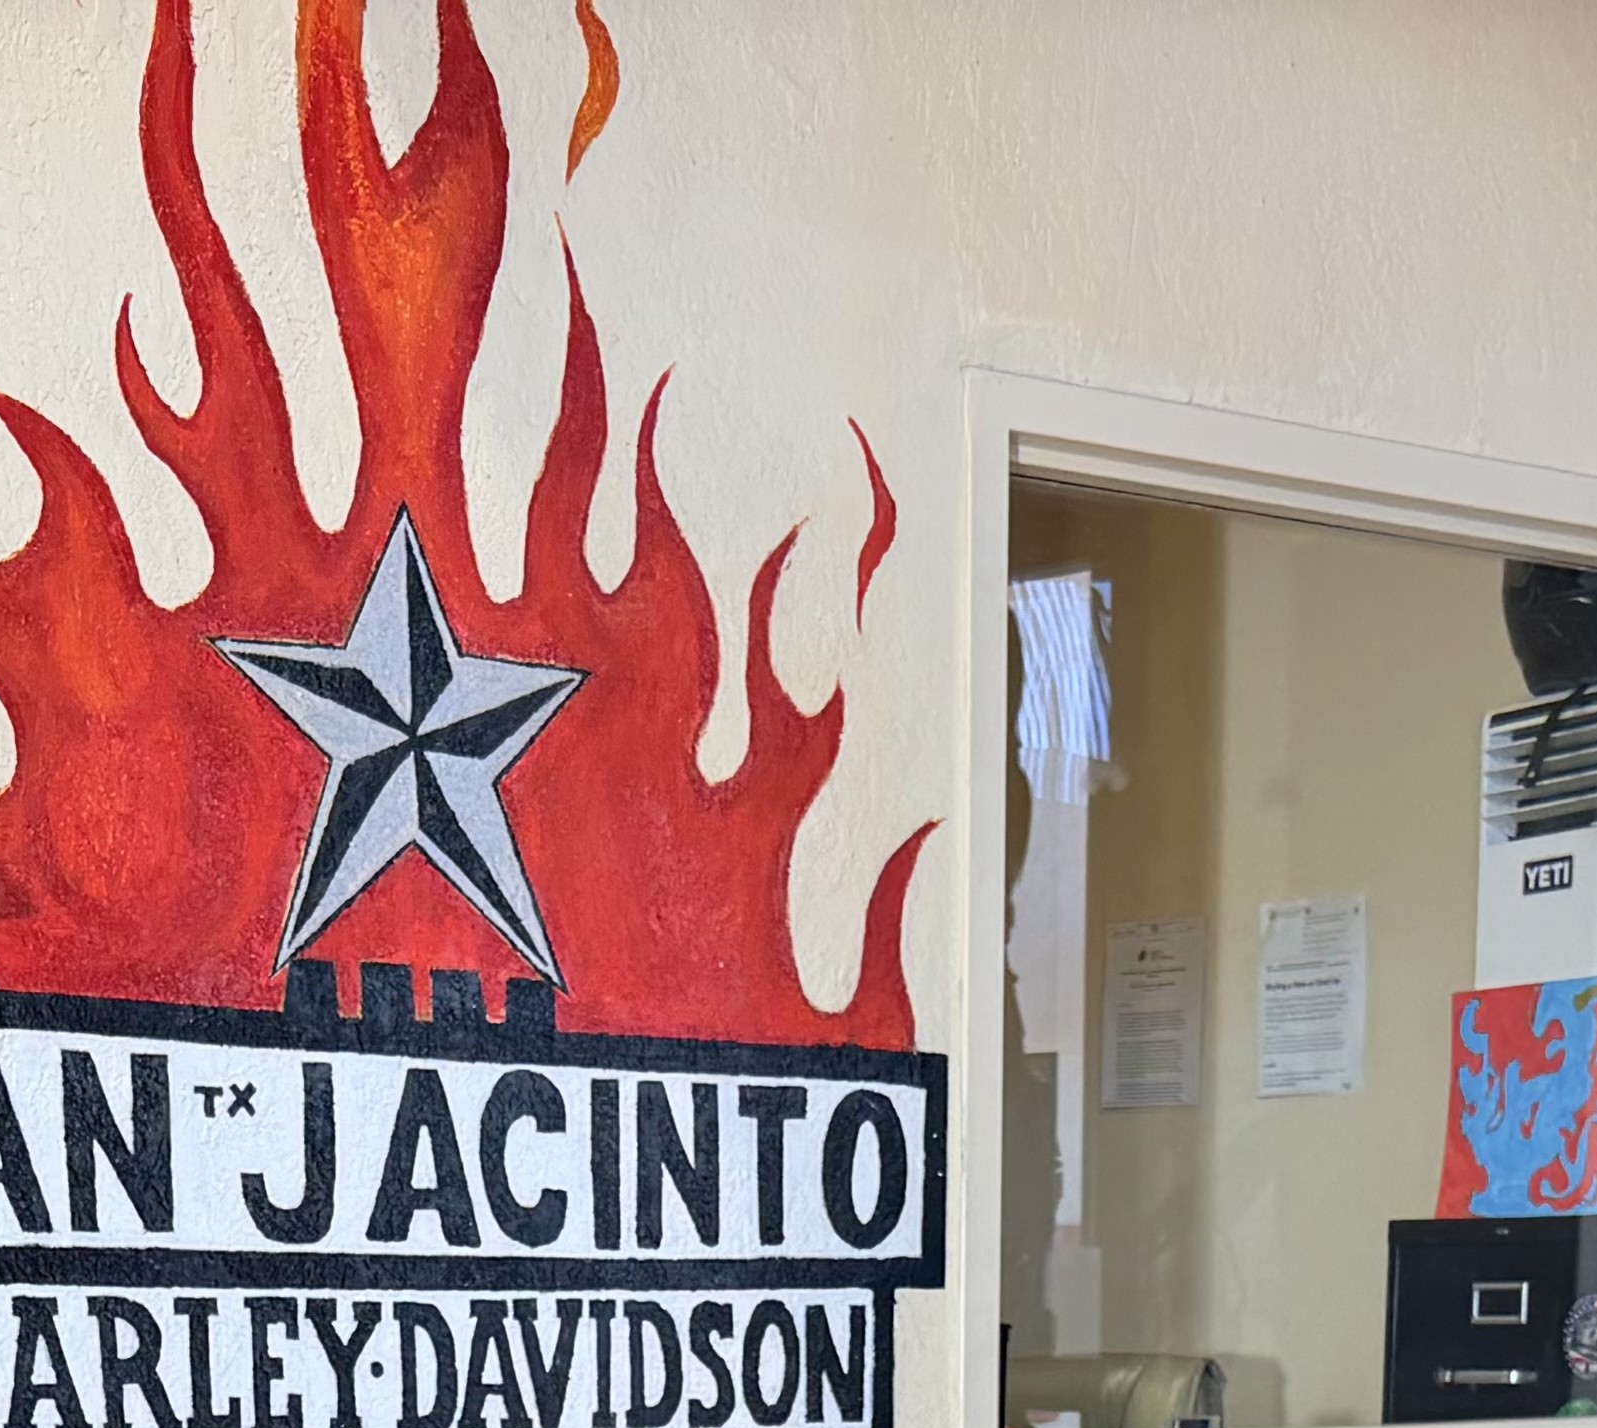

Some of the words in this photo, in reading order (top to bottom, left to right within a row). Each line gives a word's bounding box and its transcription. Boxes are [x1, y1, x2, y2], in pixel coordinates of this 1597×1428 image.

[1526, 861, 1570, 890] YETI
[193, 1084, 257, 1120] TX
[240, 1062, 910, 1252] JACINTO
